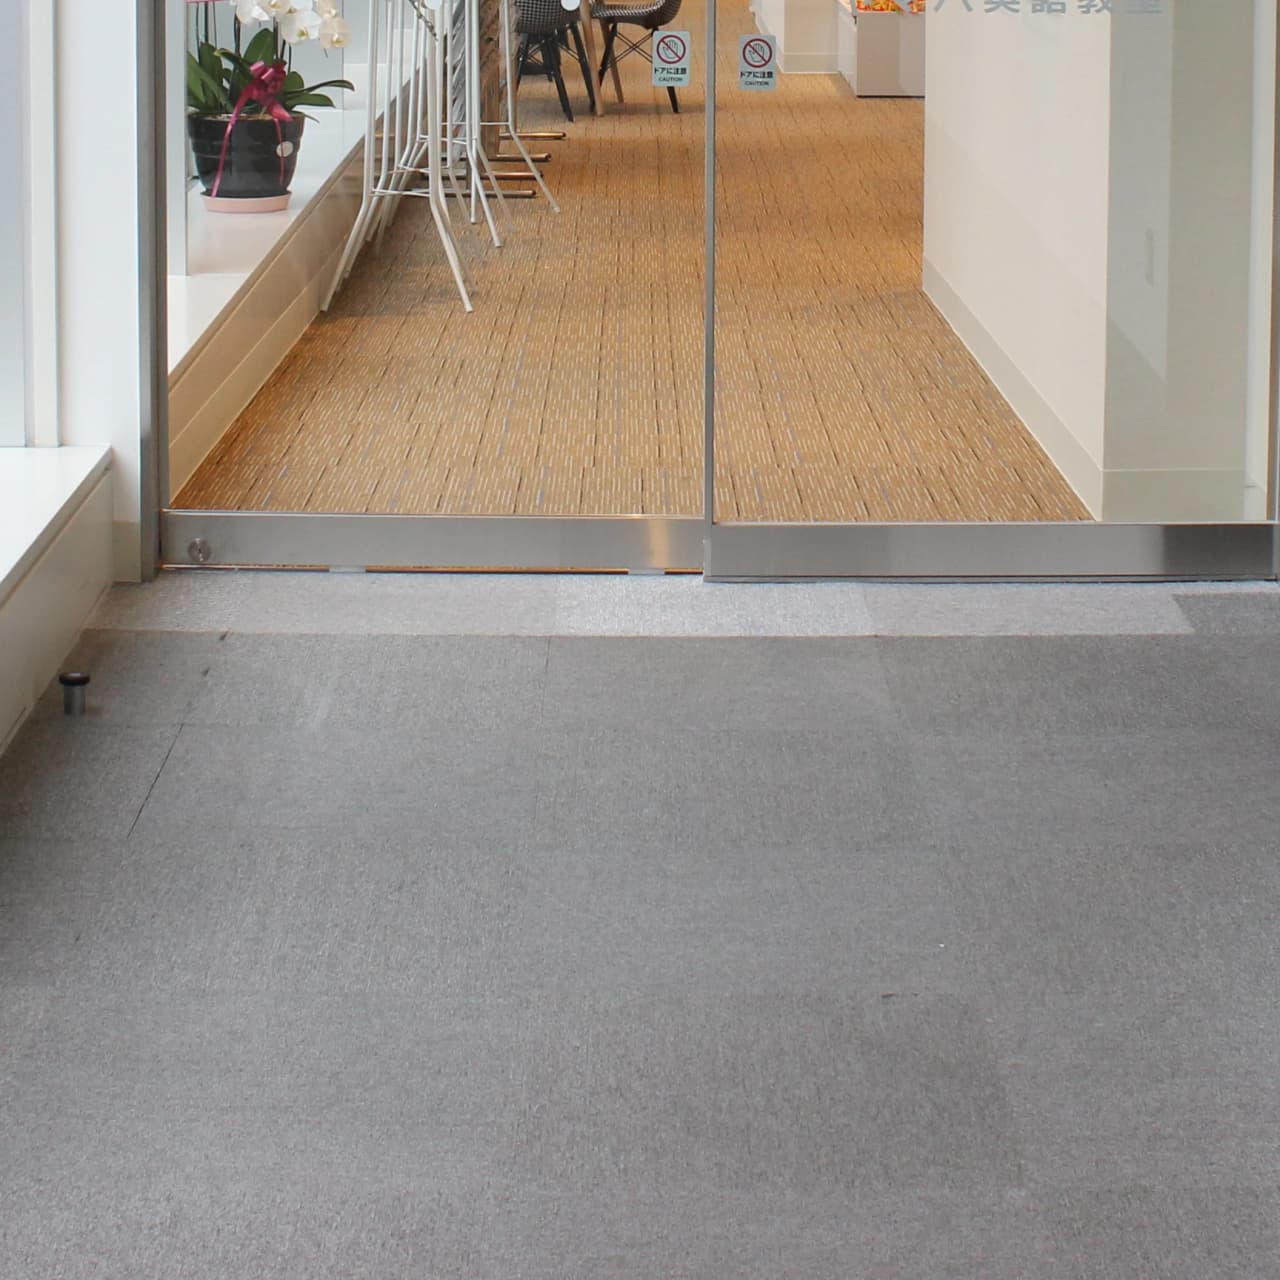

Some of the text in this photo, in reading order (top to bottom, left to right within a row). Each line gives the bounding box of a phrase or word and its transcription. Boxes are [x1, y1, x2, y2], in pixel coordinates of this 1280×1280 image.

[654, 67, 687, 75] ドアに注意
